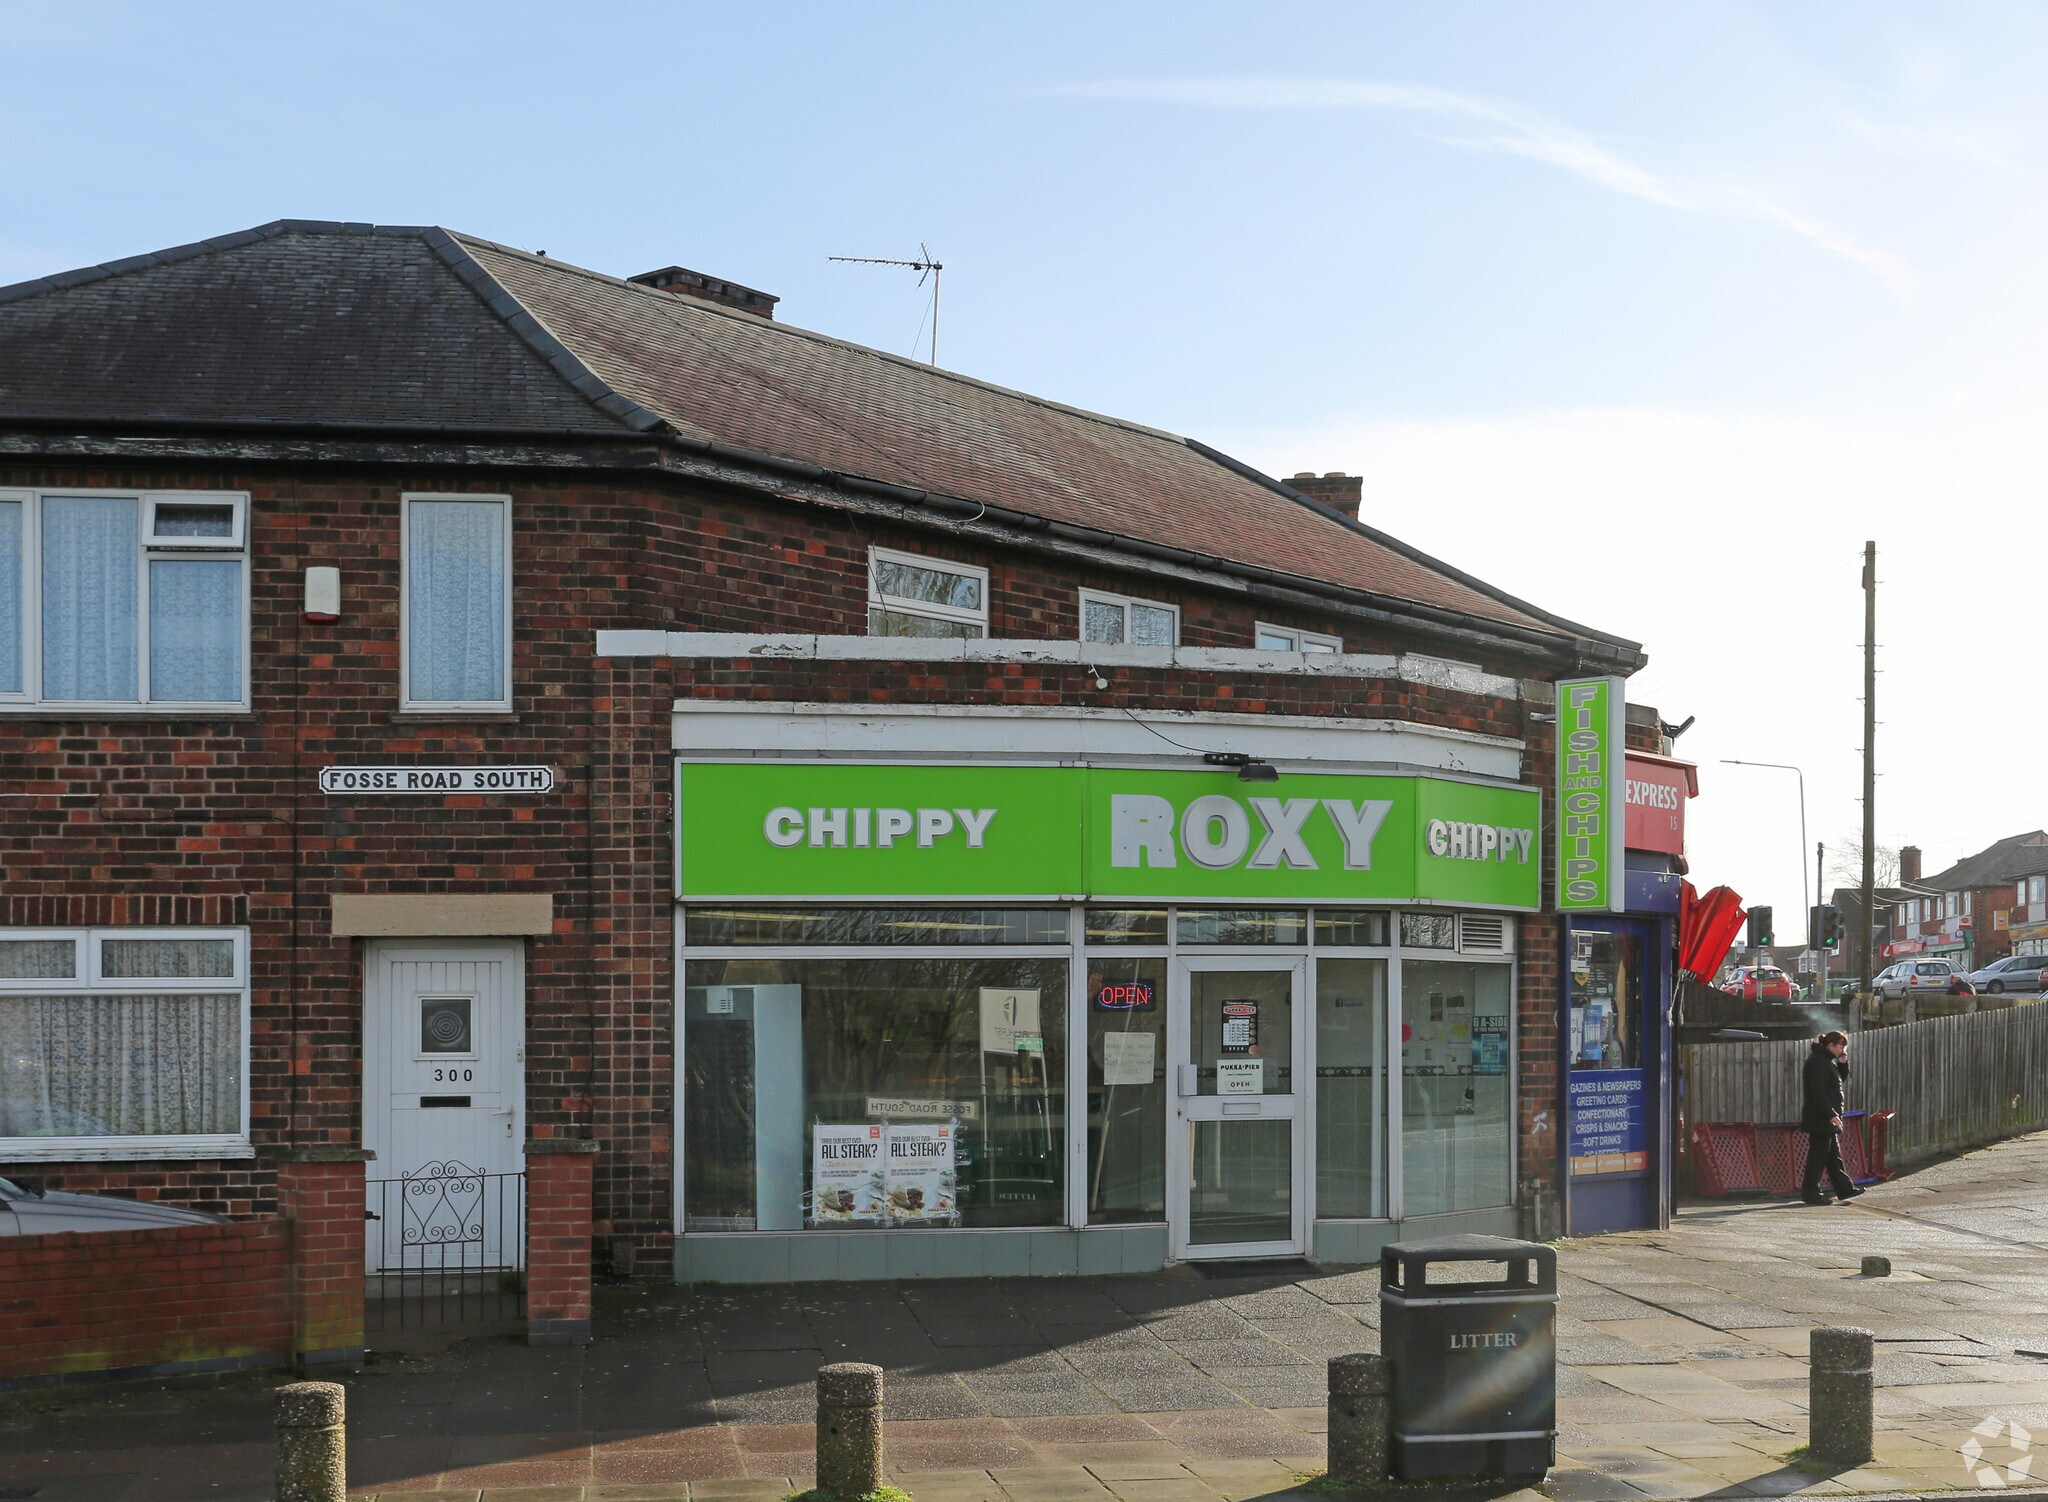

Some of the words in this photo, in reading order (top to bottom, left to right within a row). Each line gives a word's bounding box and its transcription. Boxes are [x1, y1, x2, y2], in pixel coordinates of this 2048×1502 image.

[1567, 686, 1600, 774] FISH
[330, 772, 397, 788] FOSSE
[408, 772, 462, 788] ROAD
[474, 771, 542, 788] SOUTH
[1564, 776, 1601, 790] AND
[1625, 779, 1678, 811] EXPRESS
[764, 806, 998, 849] CHIPPY
[1111, 793, 1394, 871] ROXY
[1425, 818, 1533, 864] CHIPPY
[1566, 792, 1600, 902] CHIPS
[1102, 986, 1148, 1004] OPEN
[434, 1069, 472, 1081] 300
[1602, 1080, 1642, 1091] NEWSPAPERS
[1576, 1096, 1606, 1106] GREETING
[1607, 1094, 1628, 1105] CARDS
[1577, 1108, 1627, 1120] CONFECTIONARY
[1576, 1123, 1597, 1134] CRISPS
[1604, 1121, 1628, 1131] SNACKS
[1583, 1137, 1598, 1147] SOFT
[1600, 1135, 1622, 1146] DRINKS
[822, 1145, 839, 1159] ALL
[841, 1144, 878, 1158] STEAK?
[891, 1143, 908, 1157] ALL
[910, 1142, 947, 1156] STEAK?
[1450, 1332, 1517, 1349] LITTER
